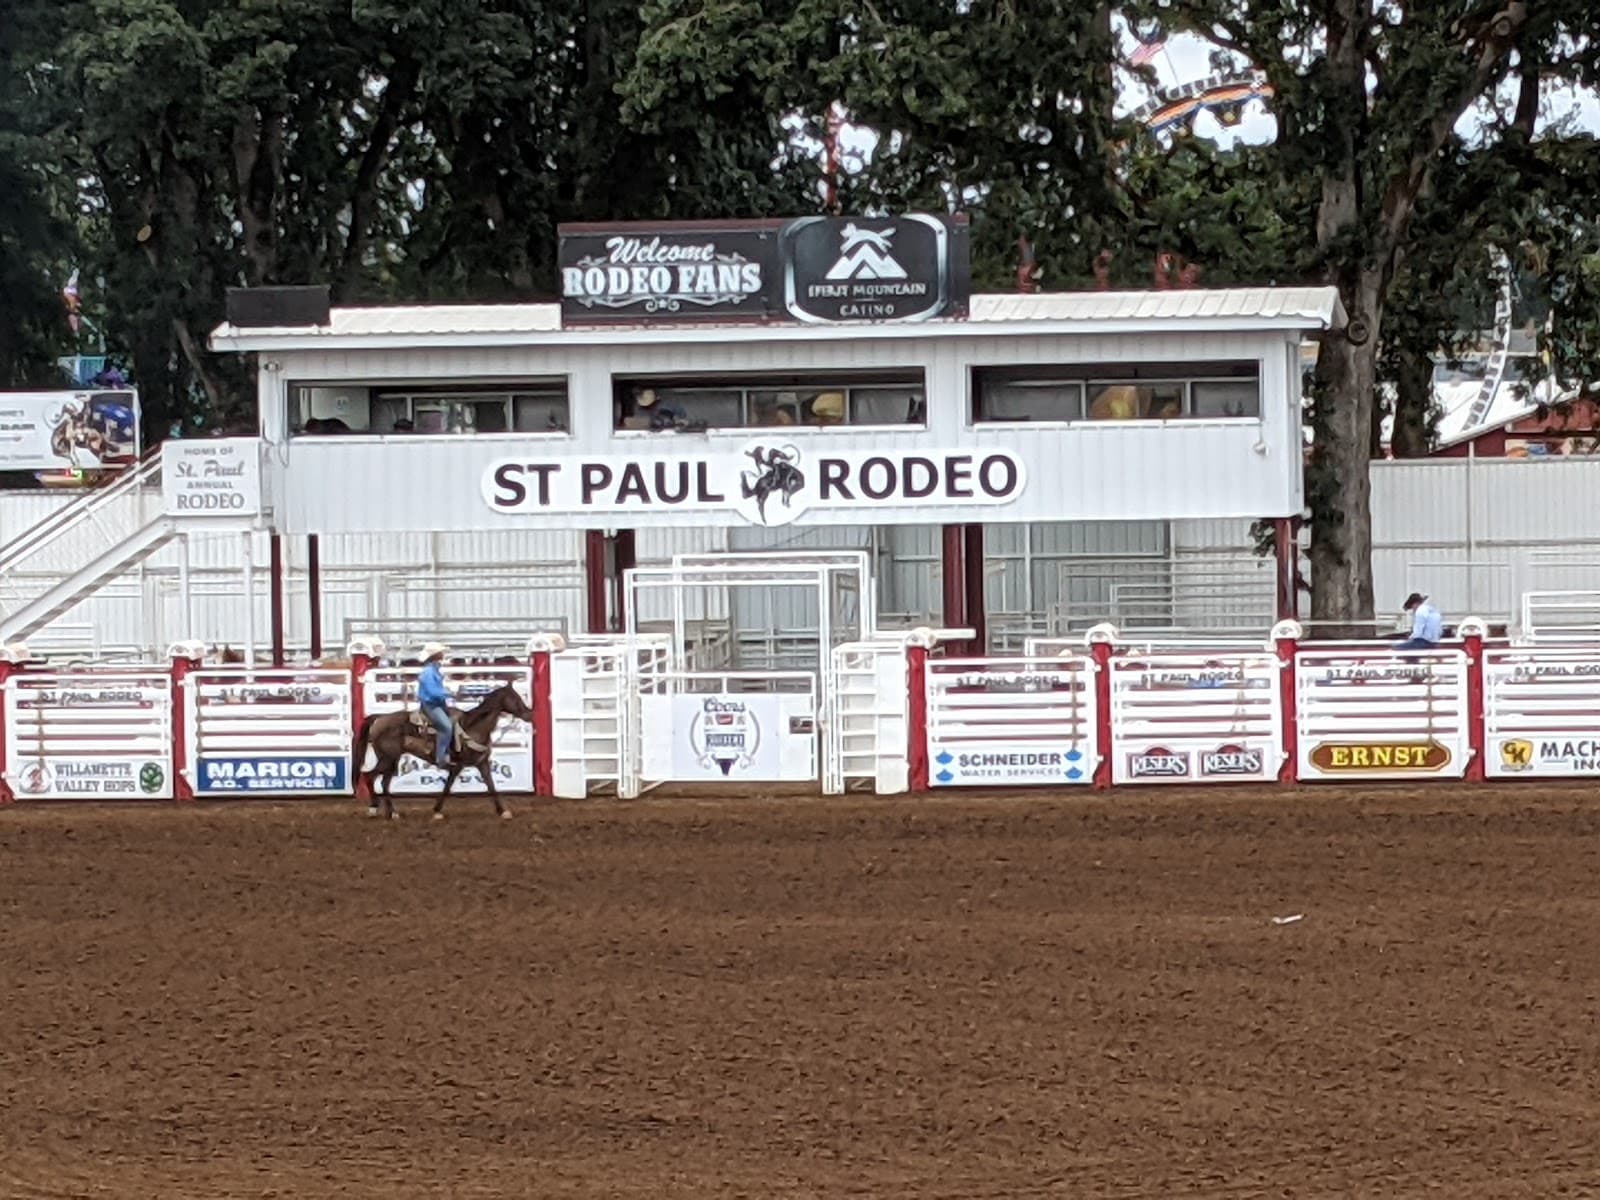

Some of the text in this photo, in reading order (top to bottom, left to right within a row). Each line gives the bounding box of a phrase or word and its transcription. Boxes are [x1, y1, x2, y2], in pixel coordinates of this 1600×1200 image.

[606, 236, 716, 264] Welcome
[563, 263, 762, 296] RODEO FANS
[853, 283, 926, 296] MOUNTAIN
[839, 304, 895, 316] CASINO
[220, 446, 234, 455] OF
[204, 460, 245, 478] Paul
[187, 481, 234, 489] ANNUAL
[494, 455, 1018, 507] ST PAUL RODEO
[177, 493, 245, 510] RODEO
[704, 696, 746, 712] Coors
[959, 753, 1062, 767] SCHNEIDER
[1331, 746, 1430, 766] ERNST
[55, 763, 132, 777] WILLAMETTE
[207, 762, 337, 778] MARION
[960, 767, 1062, 777] WATER SERVICES
[55, 780, 136, 793] VALLEY HOPS
[248, 778, 325, 788] SERVICE
